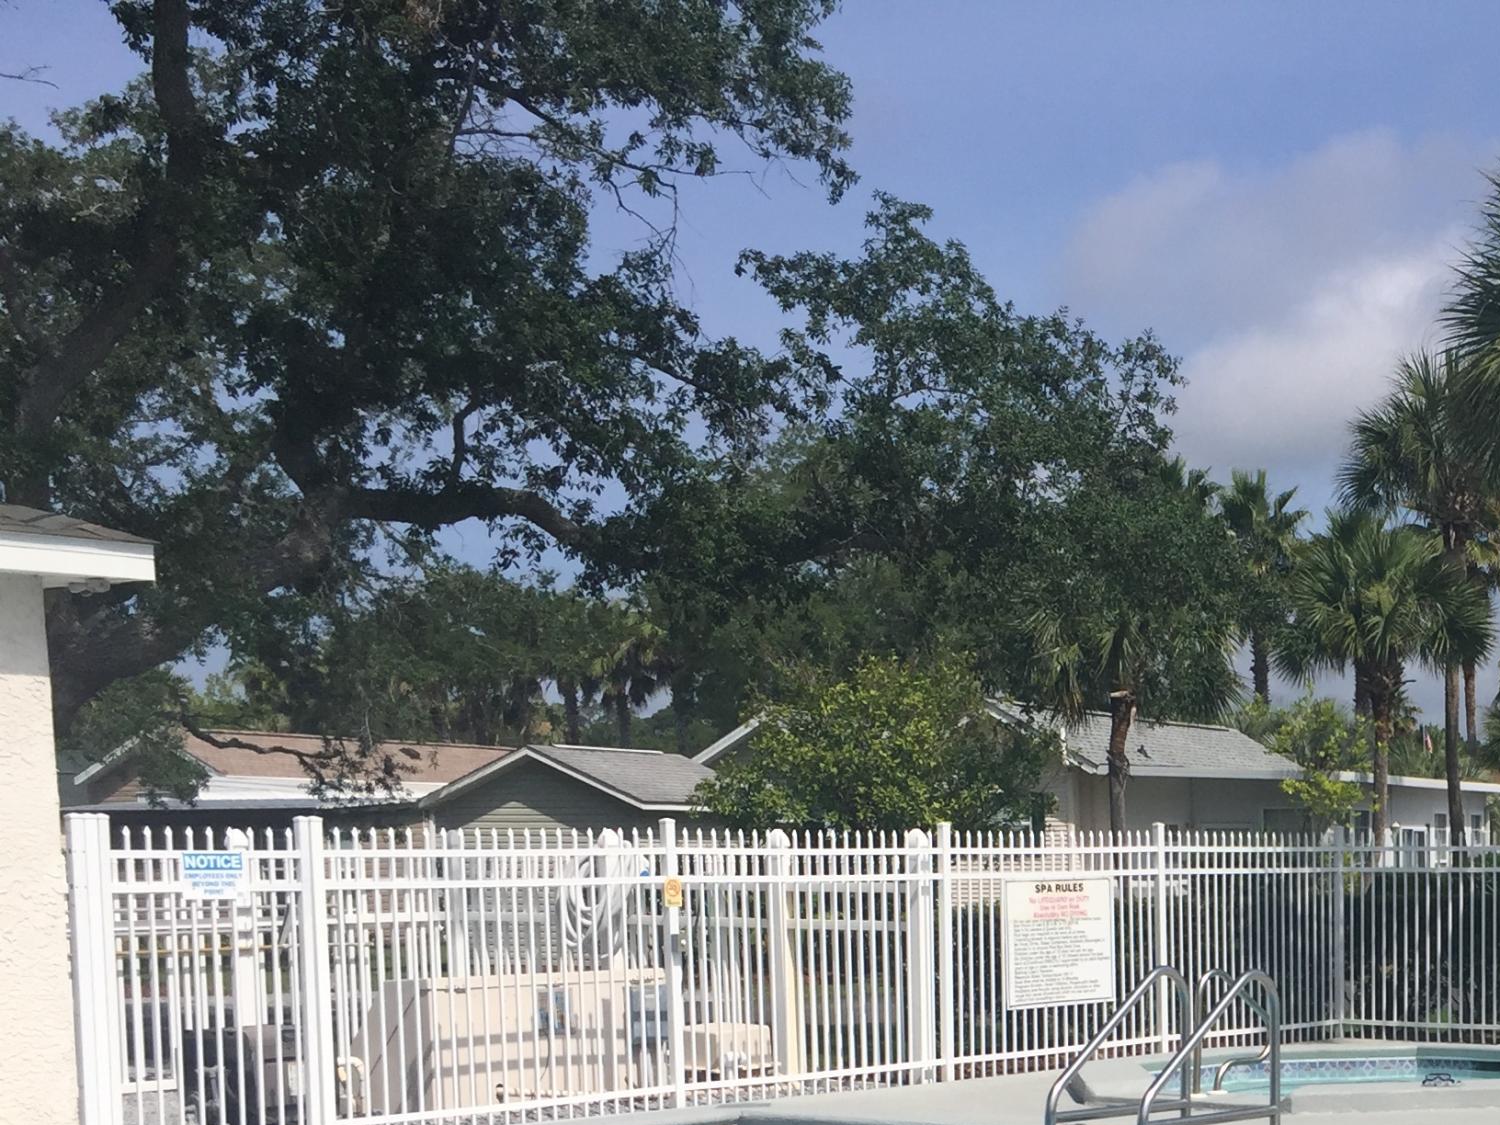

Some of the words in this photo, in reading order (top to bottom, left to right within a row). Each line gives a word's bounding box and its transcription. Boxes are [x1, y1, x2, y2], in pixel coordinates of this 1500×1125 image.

[184, 854, 242, 869] NOTICE
[184, 872, 224, 880] EMPLOYEES
[1034, 884, 1053, 894] SPA
[1055, 882, 1085, 893] RULES
